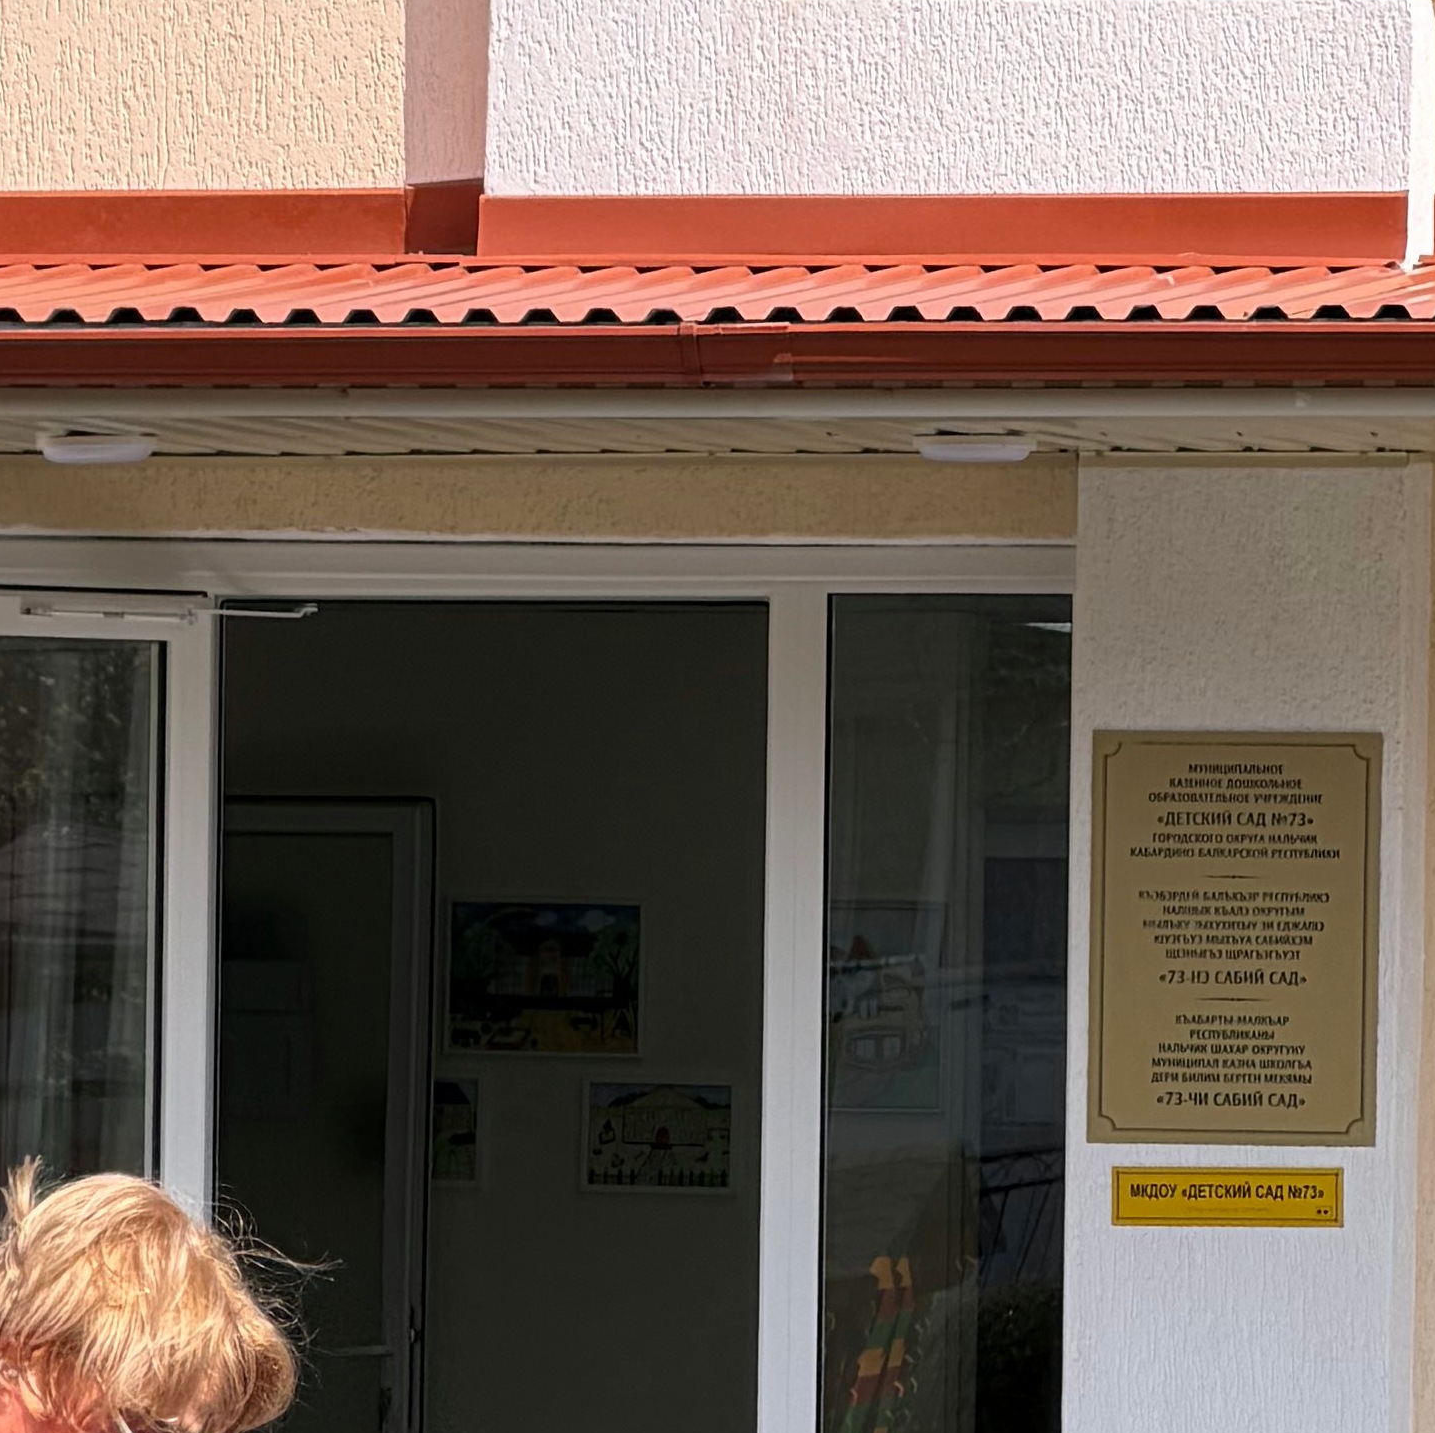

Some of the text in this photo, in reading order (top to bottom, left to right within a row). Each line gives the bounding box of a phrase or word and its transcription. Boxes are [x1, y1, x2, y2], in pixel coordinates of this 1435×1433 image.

[1236, 811, 1267, 828] САД
[1214, 968, 1265, 985] САБИЙ
[1213, 1090, 1263, 1107] САБИЙ
[1267, 1092, 1306, 1110] САД»
[1130, 1181, 1325, 1202] МКДОУ «ДЕТСКИЙ САД №73»
